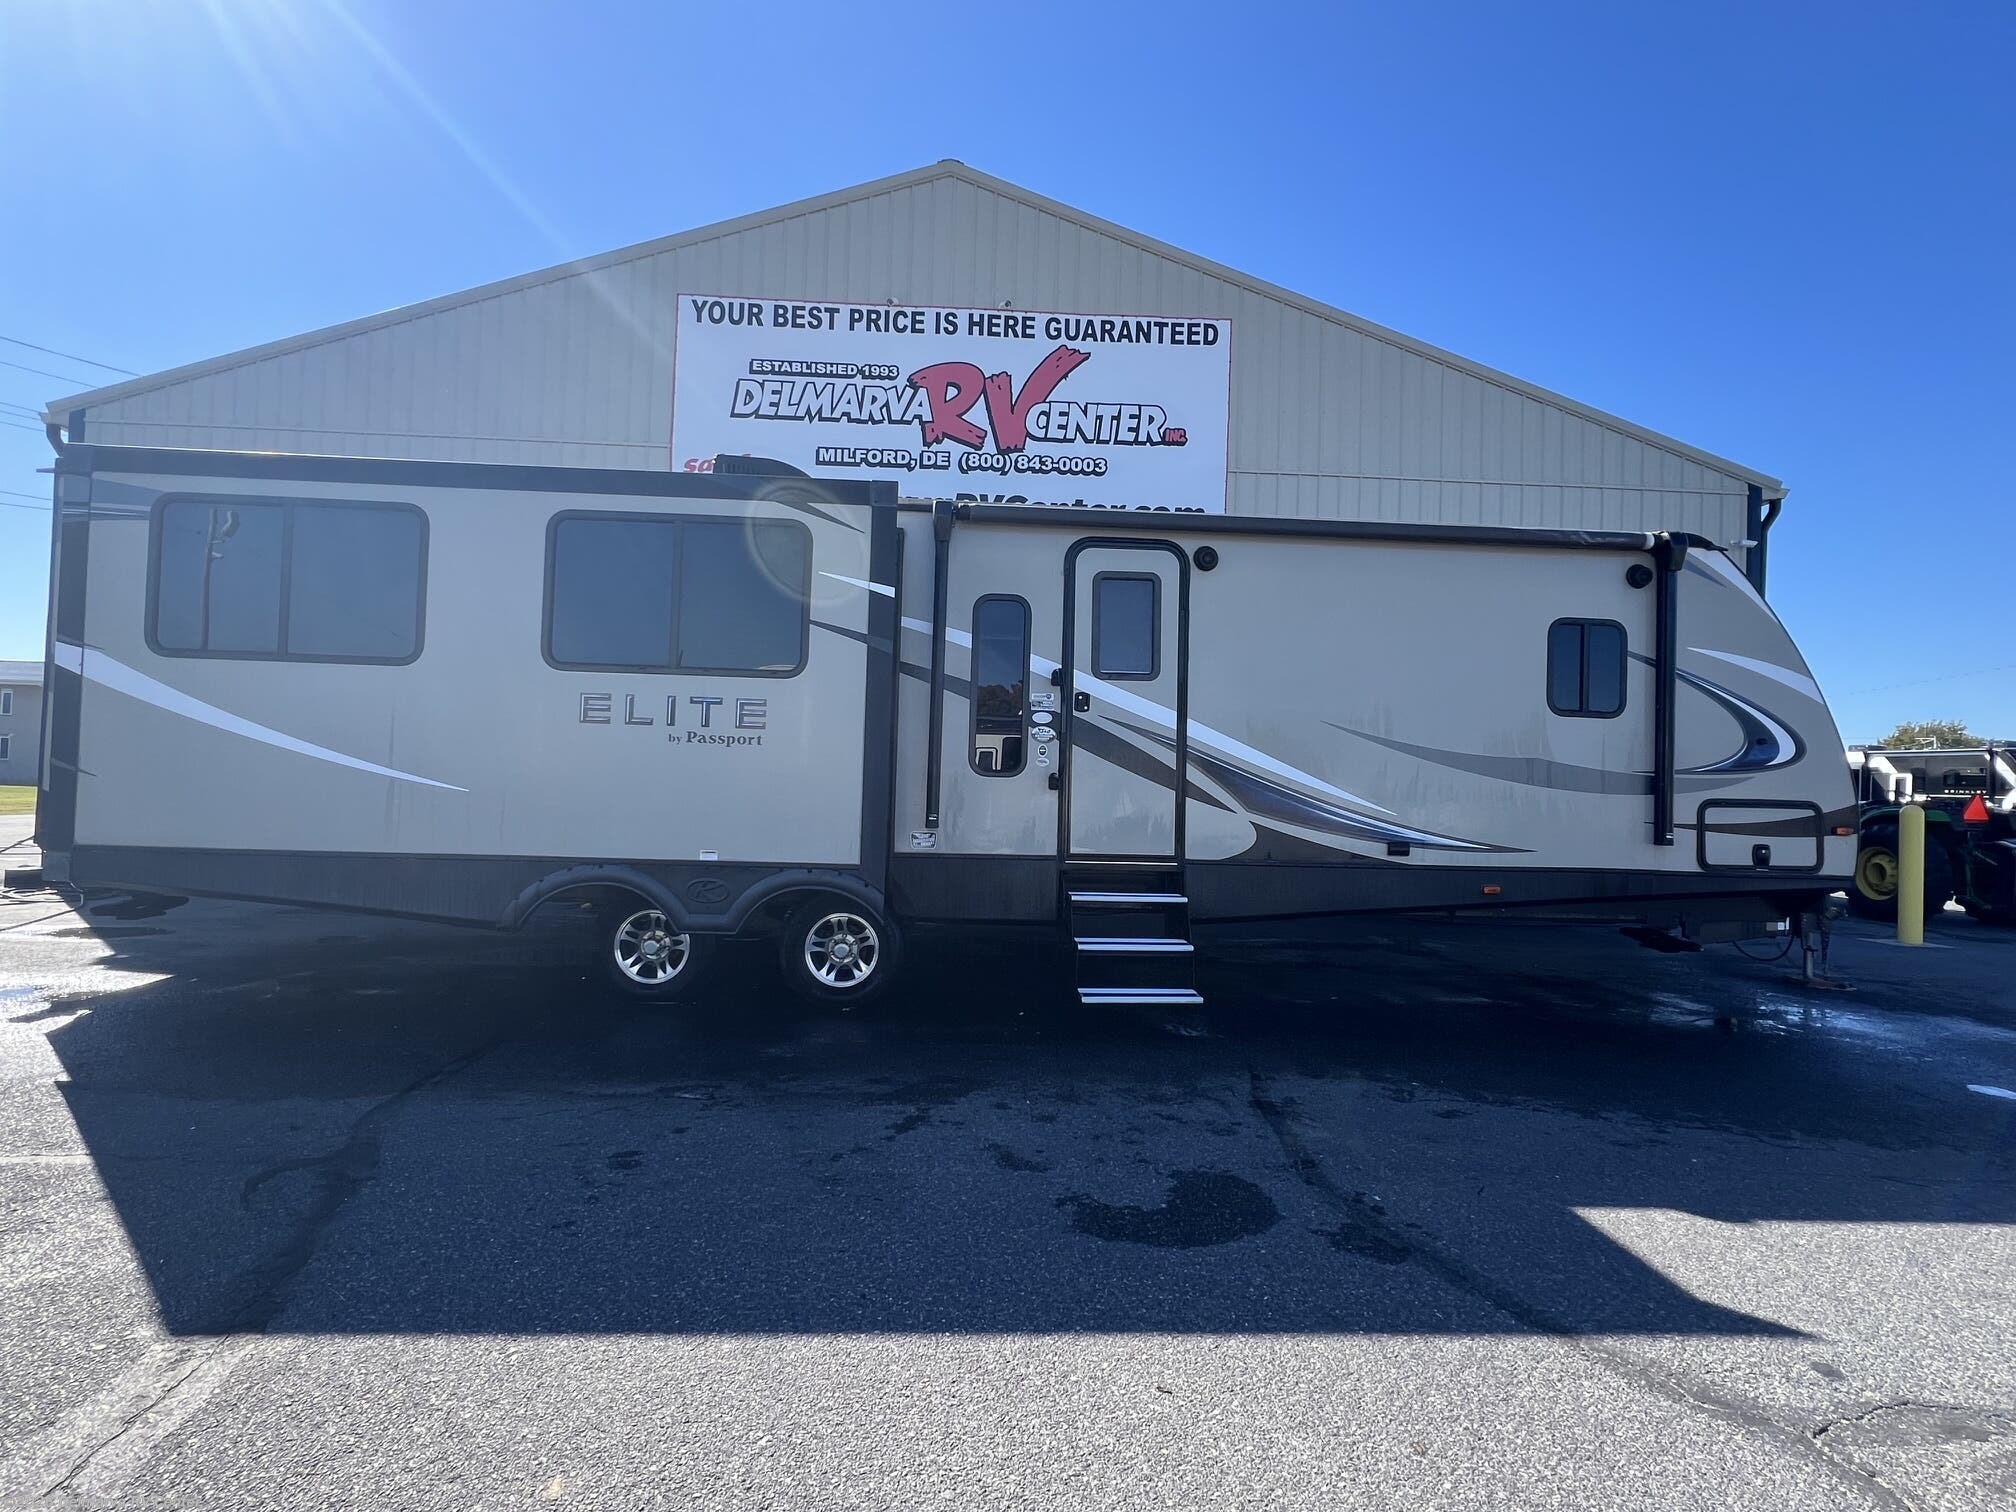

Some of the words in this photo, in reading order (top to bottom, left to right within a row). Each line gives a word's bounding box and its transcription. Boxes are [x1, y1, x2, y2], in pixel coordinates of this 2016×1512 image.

[691, 299, 764, 327] YOUR
[772, 304, 840, 331] BEST
[849, 308, 926, 334] PRICE
[934, 312, 958, 335] IS
[968, 313, 1036, 339] HERE
[1045, 317, 1219, 346] GUARANTEED
[751, 359, 859, 377] ESTABLISHED
[860, 364, 900, 379] 1993
[731, 379, 934, 424] DELMARVA
[907, 345, 1091, 453] RV
[1026, 401, 1167, 446] CENTER
[816, 447, 917, 471] MILFORD,
[920, 451, 950, 469] DE
[958, 452, 1012, 475] (800)
[1014, 455, 1108, 477] 843-0003
[579, 692, 767, 730] ELITE
[668, 733, 682, 745] by
[686, 730, 763, 748] Passport
